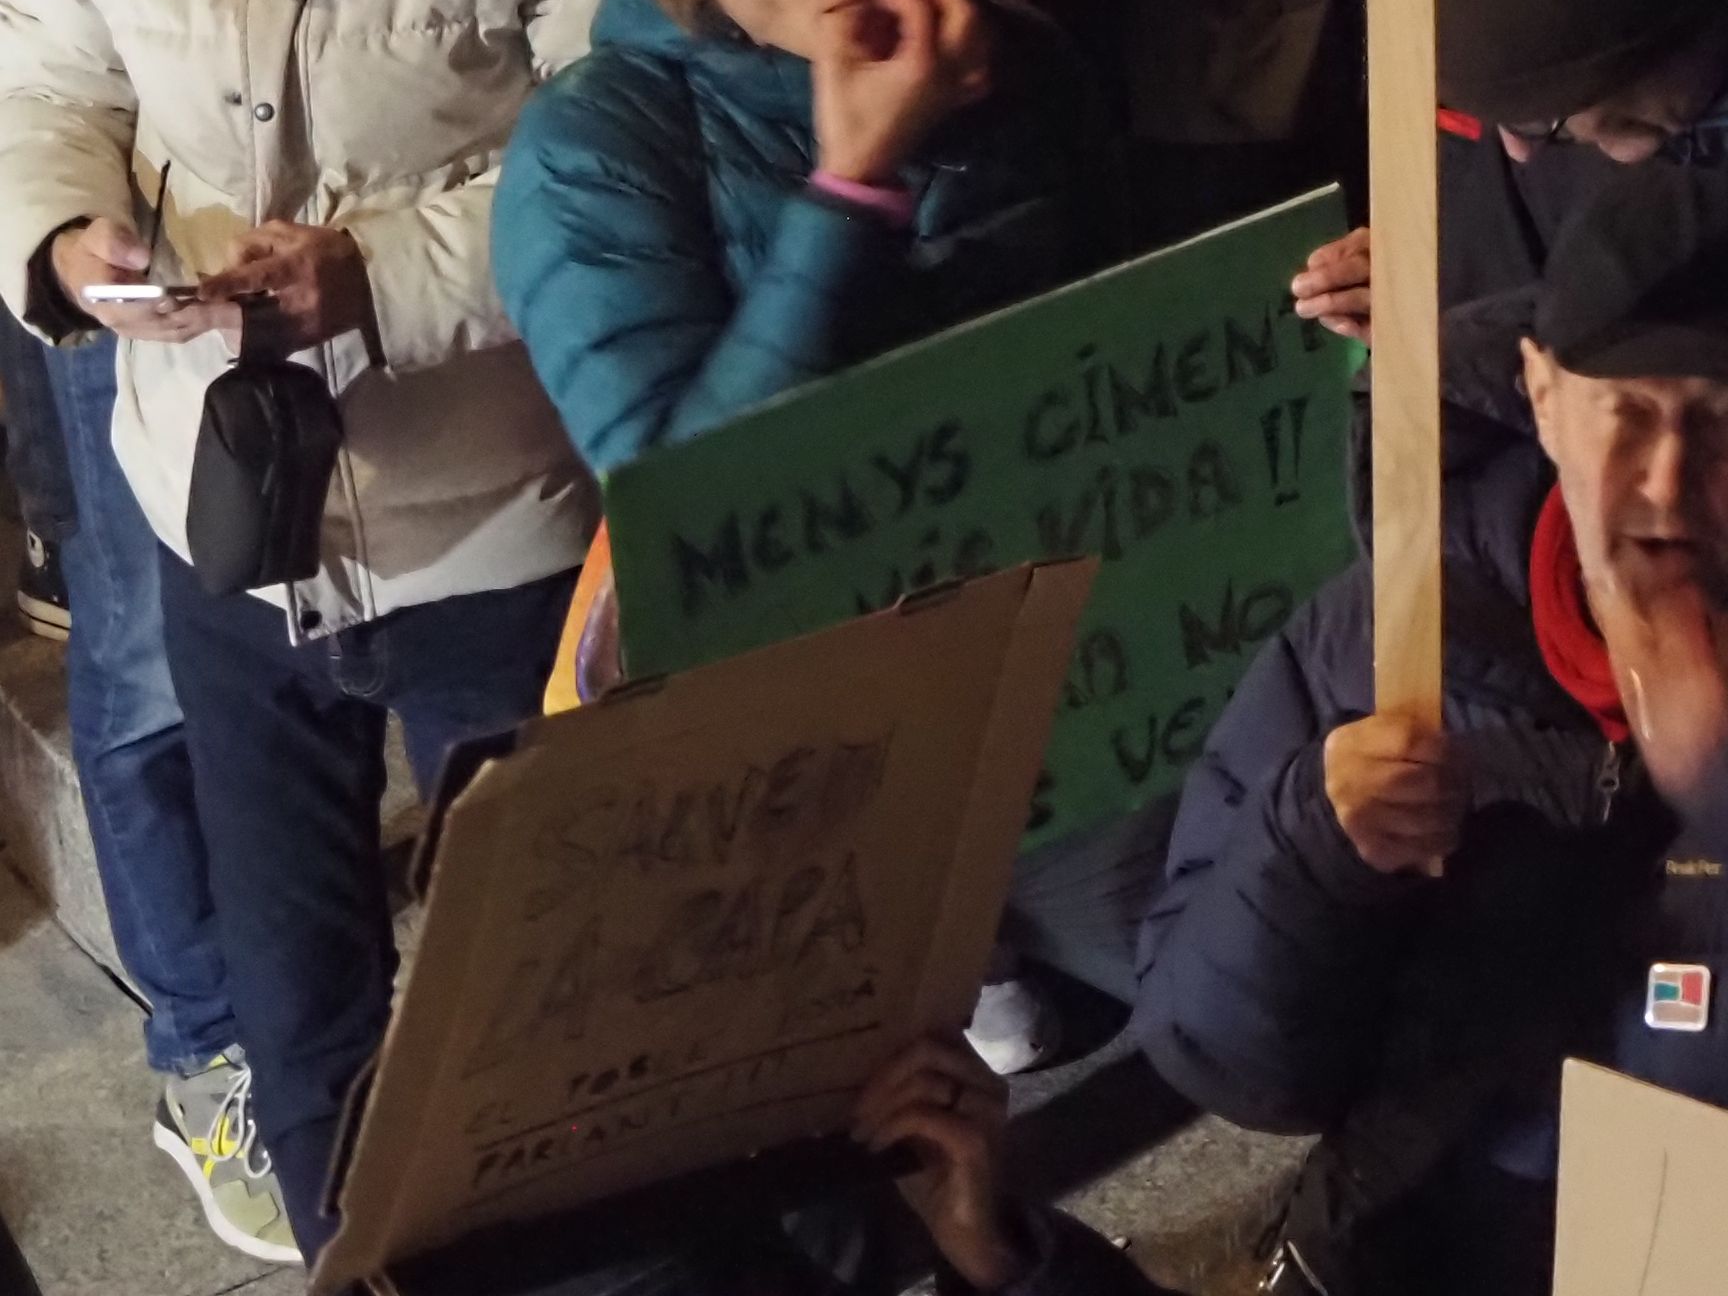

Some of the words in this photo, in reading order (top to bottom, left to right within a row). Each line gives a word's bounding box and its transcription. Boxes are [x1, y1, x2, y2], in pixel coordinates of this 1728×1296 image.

[672, 415, 972, 616] MENYS
[1178, 578, 1294, 670] NO
[1109, 684, 1237, 784] VE
